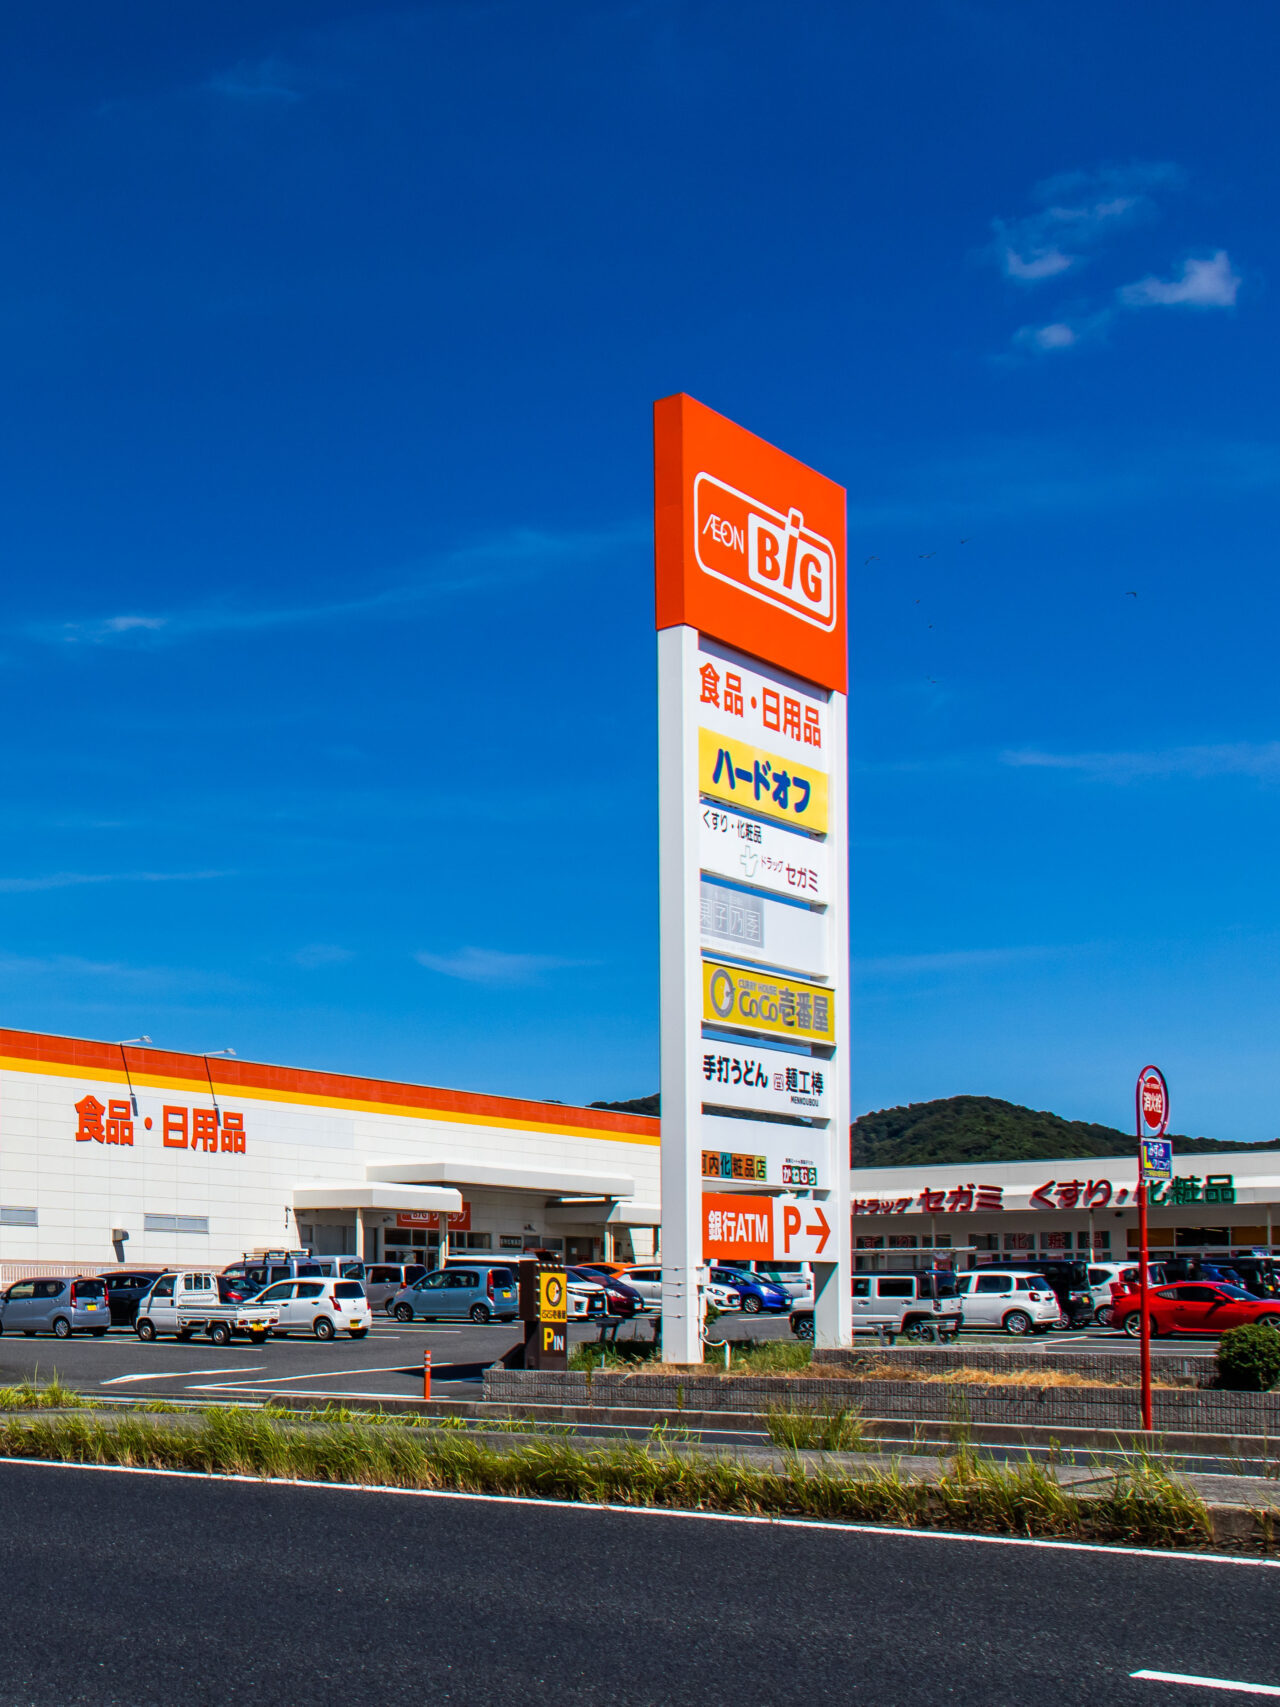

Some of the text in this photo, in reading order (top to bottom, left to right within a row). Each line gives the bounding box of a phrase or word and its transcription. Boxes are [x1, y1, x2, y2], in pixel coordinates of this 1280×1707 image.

[699, 662, 821, 748] 食品・日用品
[712, 748, 811, 813] ハードオフ
[702, 809, 762, 844] くすり・化粧品
[785, 863, 819, 892] セガミ
[738, 987, 829, 1033] CoCo壱番屋
[703, 1054, 768, 1088] 手打うどん
[1144, 1092, 1162, 1113] 消火栓
[74, 1094, 246, 1154] 食品・日用品
[853, 1183, 1004, 1214] ドラッグ セガミ
[708, 1210, 769, 1243] 銀行ATM
[783, 1205, 801, 1254] P
